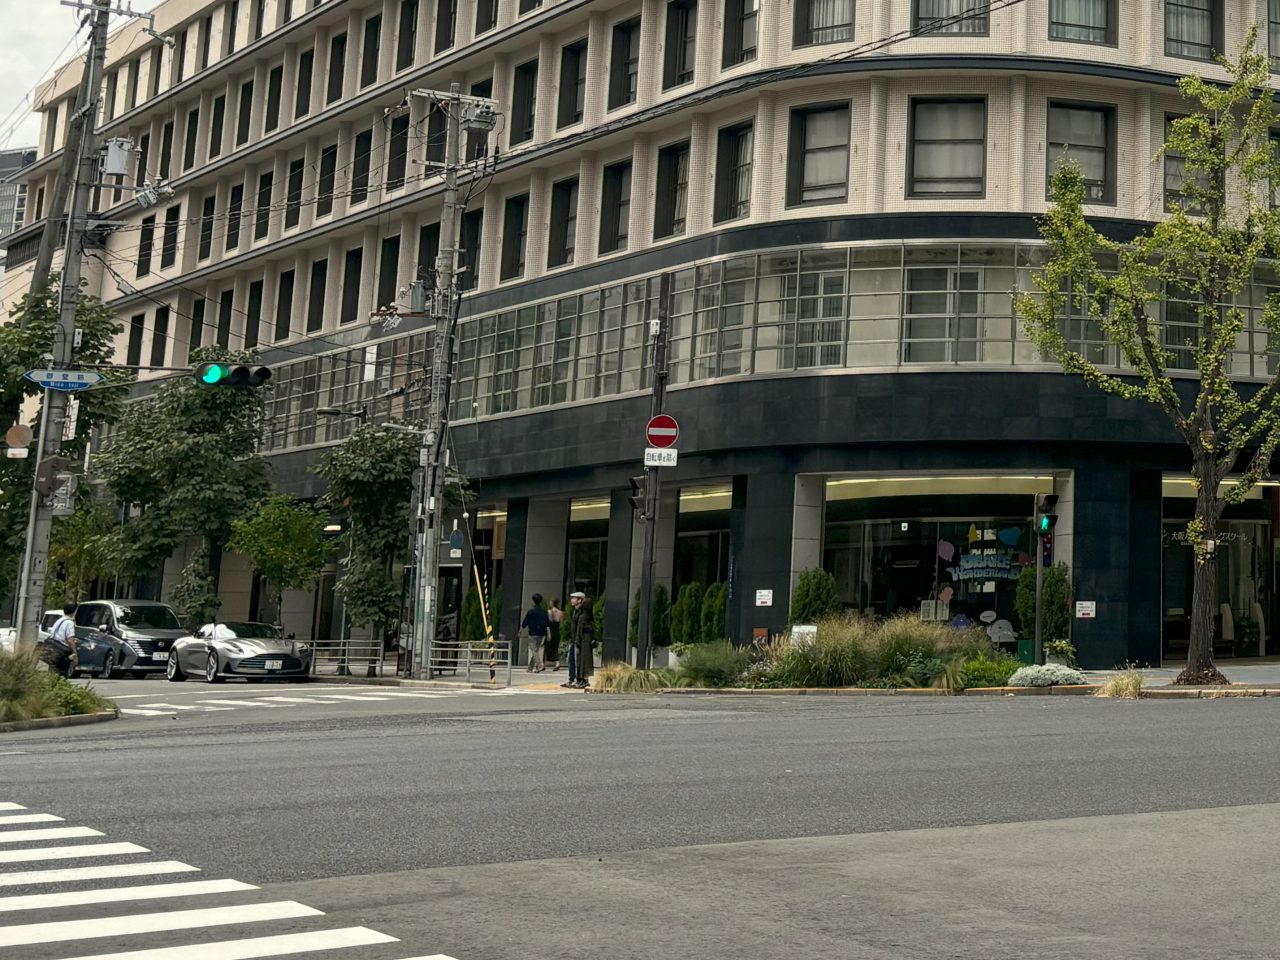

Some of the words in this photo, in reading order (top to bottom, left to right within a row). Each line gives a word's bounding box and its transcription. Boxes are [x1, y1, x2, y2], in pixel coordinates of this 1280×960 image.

[646, 452, 676, 462] 自転車を除く
